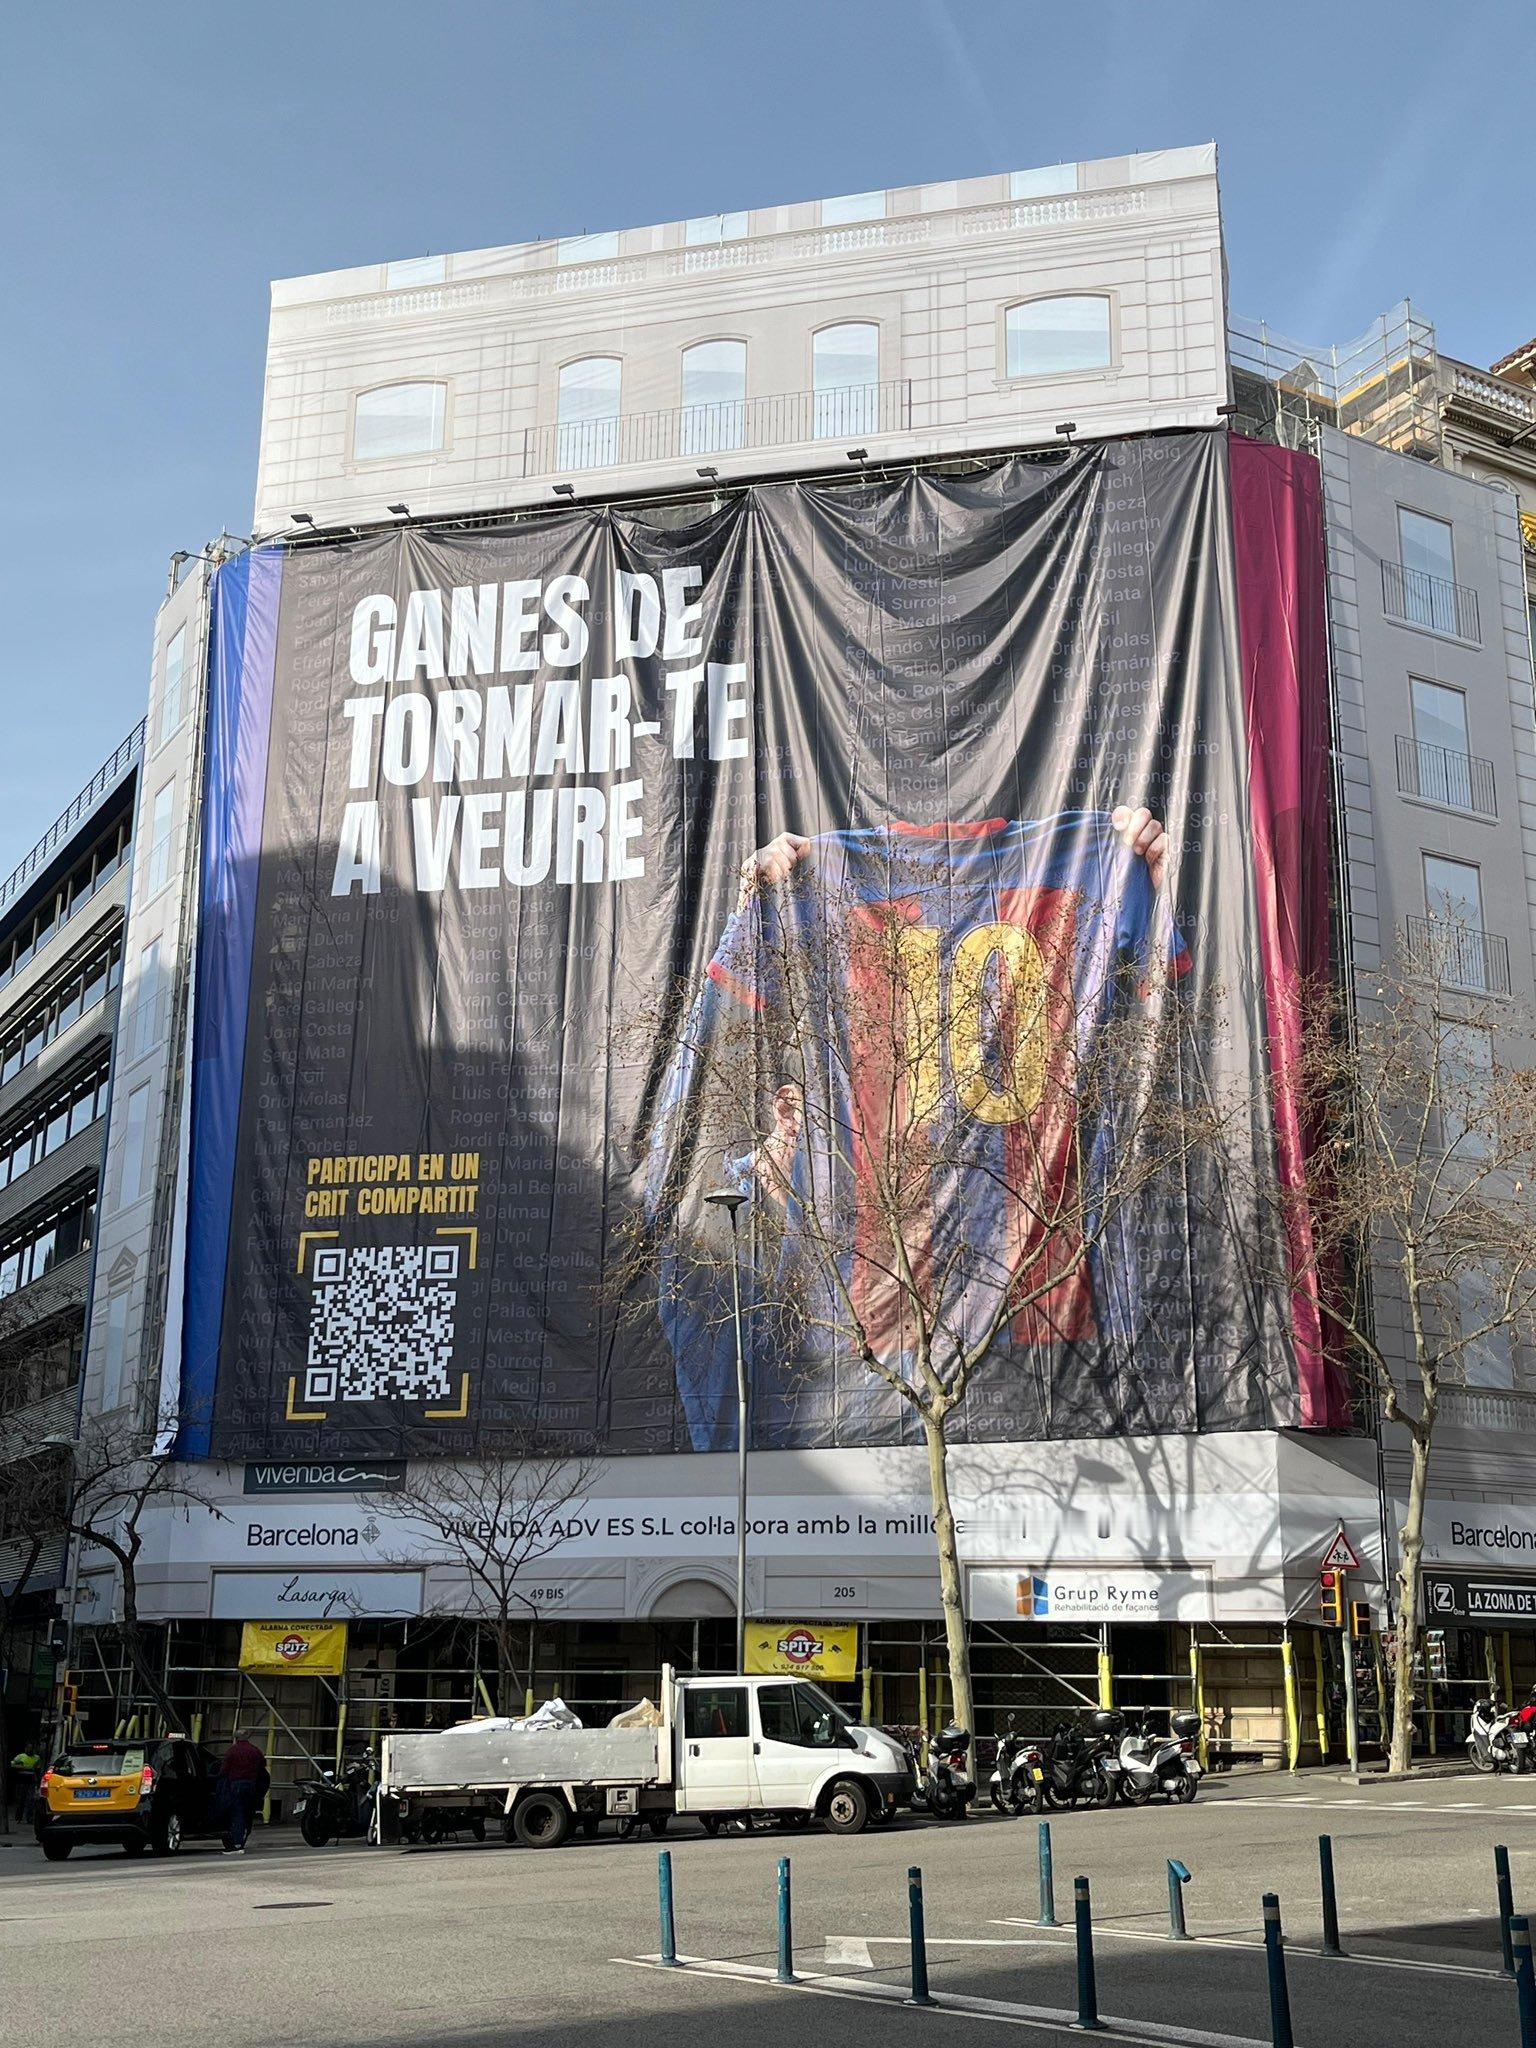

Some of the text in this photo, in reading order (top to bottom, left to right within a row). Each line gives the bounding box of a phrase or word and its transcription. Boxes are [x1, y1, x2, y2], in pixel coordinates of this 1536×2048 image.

[1089, 540, 1156, 561] Gallego
[891, 594, 958, 612] Surroca
[349, 566, 703, 685] GANES DE
[927, 629, 989, 653] Volpini
[344, 662, 748, 788] TORNAR-TE
[900, 776, 940, 793] Roig
[331, 779, 645, 896] A VEURE
[313, 930, 354, 947] Duch
[303, 995, 365, 1015] Gallego
[304, 1021, 353, 1038] Costa
[896, 922, 1049, 1124] 10
[304, 1044, 347, 1061] Mata
[453, 1062, 486, 1078] Pau
[450, 1106, 556, 1127] Roger Pasto
[449, 1131, 493, 1149] Jordi
[308, 1154, 411, 1185] PARTICIPA
[418, 1154, 444, 1181] EN
[451, 1152, 479, 1180] UN
[503, 1154, 554, 1172] Maria
[305, 1185, 479, 1217] CRIT COMPARTIT
[484, 1203, 551, 1220] Dalmau
[512, 1251, 534, 1268] de
[537, 1249, 596, 1269] Sevilla
[489, 1276, 570, 1297] Bruguera
[485, 1326, 549, 1344] Mestre
[485, 1351, 554, 1369] Surroca
[491, 1376, 558, 1396] Medina
[247, 1522, 359, 1547] Barcelona
[440, 1519, 544, 1539] VIVENDA
[549, 1518, 601, 1538] ADV
[608, 1517, 635, 1536] ES
[641, 1517, 674, 1536] S.L
[797, 1514, 850, 1534] amb
[858, 1514, 877, 1534] la
[530, 1587, 565, 1600] 49 BIS
[833, 1586, 856, 1598] 205
[1054, 1585, 1159, 1603] Grup Ryme
[1437, 1587, 1451, 1607] Z
[1054, 1602, 1160, 1612] Rehabilitació de façanes
[1468, 1592, 1532, 1611] LA ZONA DE
[276, 1643, 309, 1652] SPITZ
[777, 1641, 823, 1653] SPITZ
